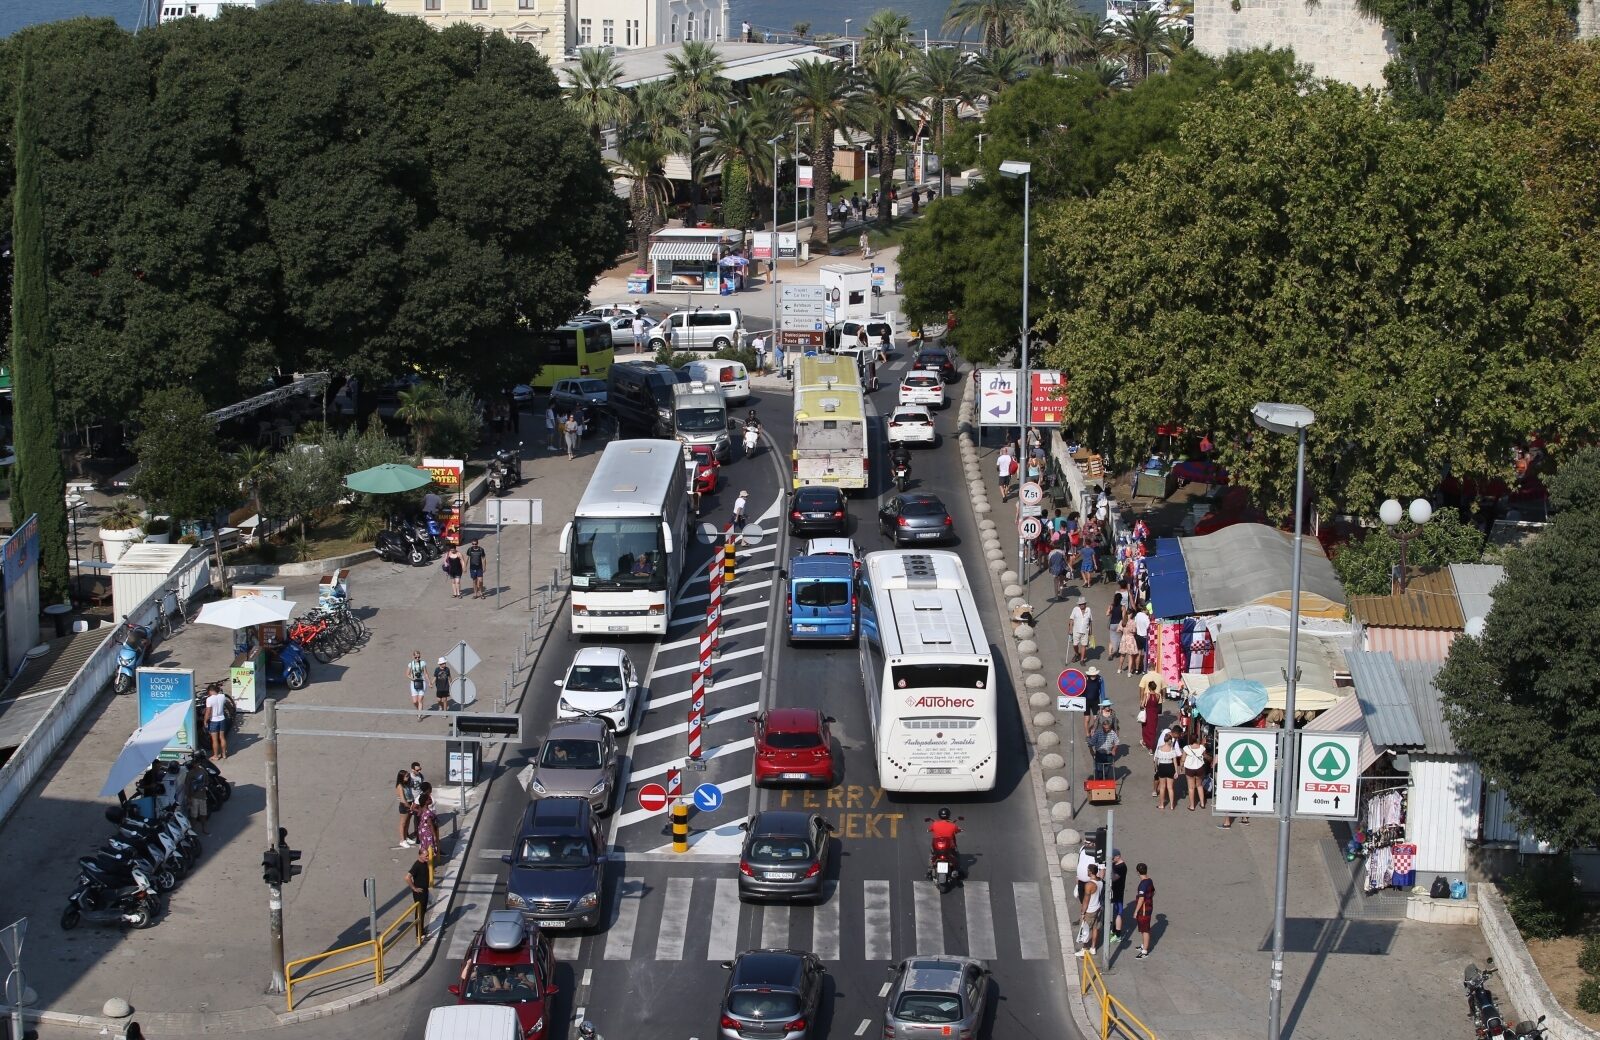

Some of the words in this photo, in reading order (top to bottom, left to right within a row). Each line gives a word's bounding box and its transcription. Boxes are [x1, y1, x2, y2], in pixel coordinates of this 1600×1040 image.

[990, 378, 1011, 389] dm
[1024, 523, 1036, 533] 40
[1223, 781, 1267, 789] SPAR
[1306, 784, 1350, 793] SPAR
[781, 785, 885, 808] FERRY
[829, 813, 904, 838] JEKT
